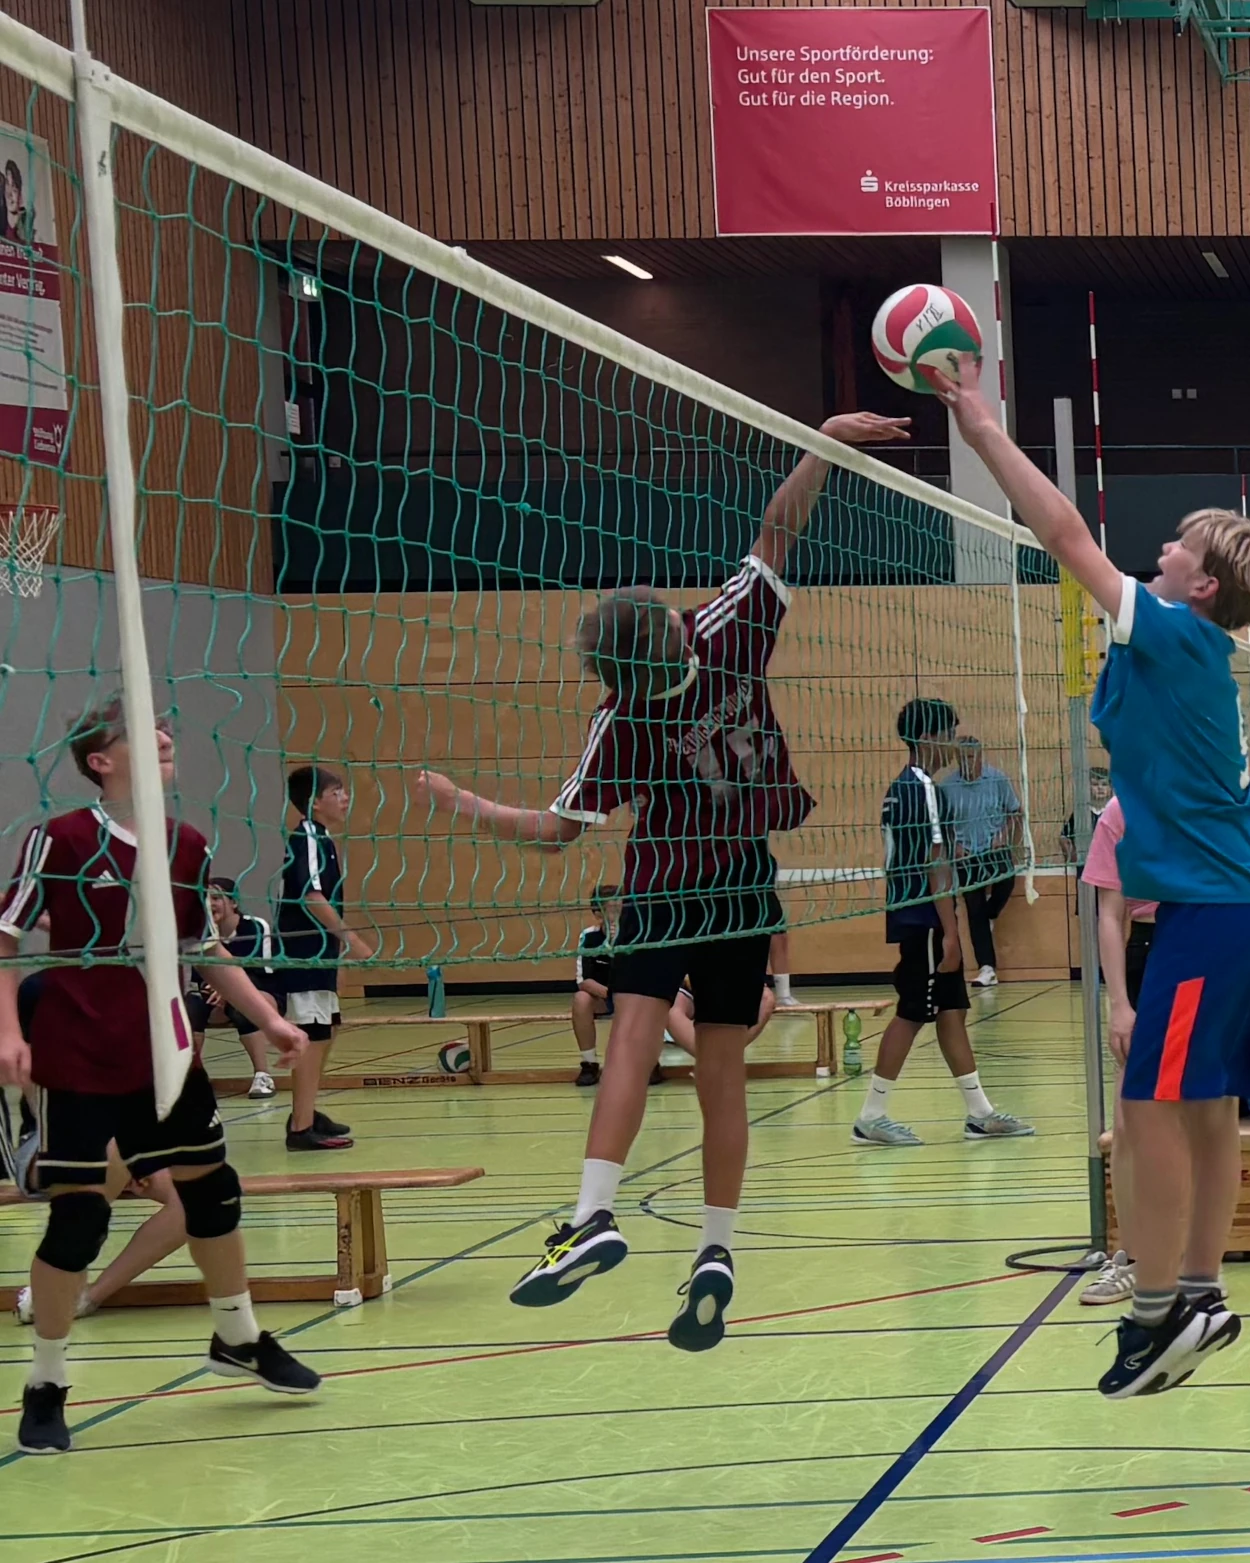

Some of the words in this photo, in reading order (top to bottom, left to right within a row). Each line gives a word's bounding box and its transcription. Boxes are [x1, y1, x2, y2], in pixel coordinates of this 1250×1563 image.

[736, 46, 796, 62] Unsere
[800, 45, 934, 64] Sportförderung:
[738, 69, 768, 84] Gut
[771, 68, 795, 84] für
[799, 69, 830, 84] den
[835, 68, 885, 86] Sport.
[739, 91, 769, 106] Gut
[772, 90, 796, 106] für
[800, 90, 826, 105] die
[830, 91, 895, 109] Region.
[884, 181, 979, 194] Kreissparkasse
[886, 196, 950, 210] Böblingen
[364, 1077, 420, 1086] BENZ
